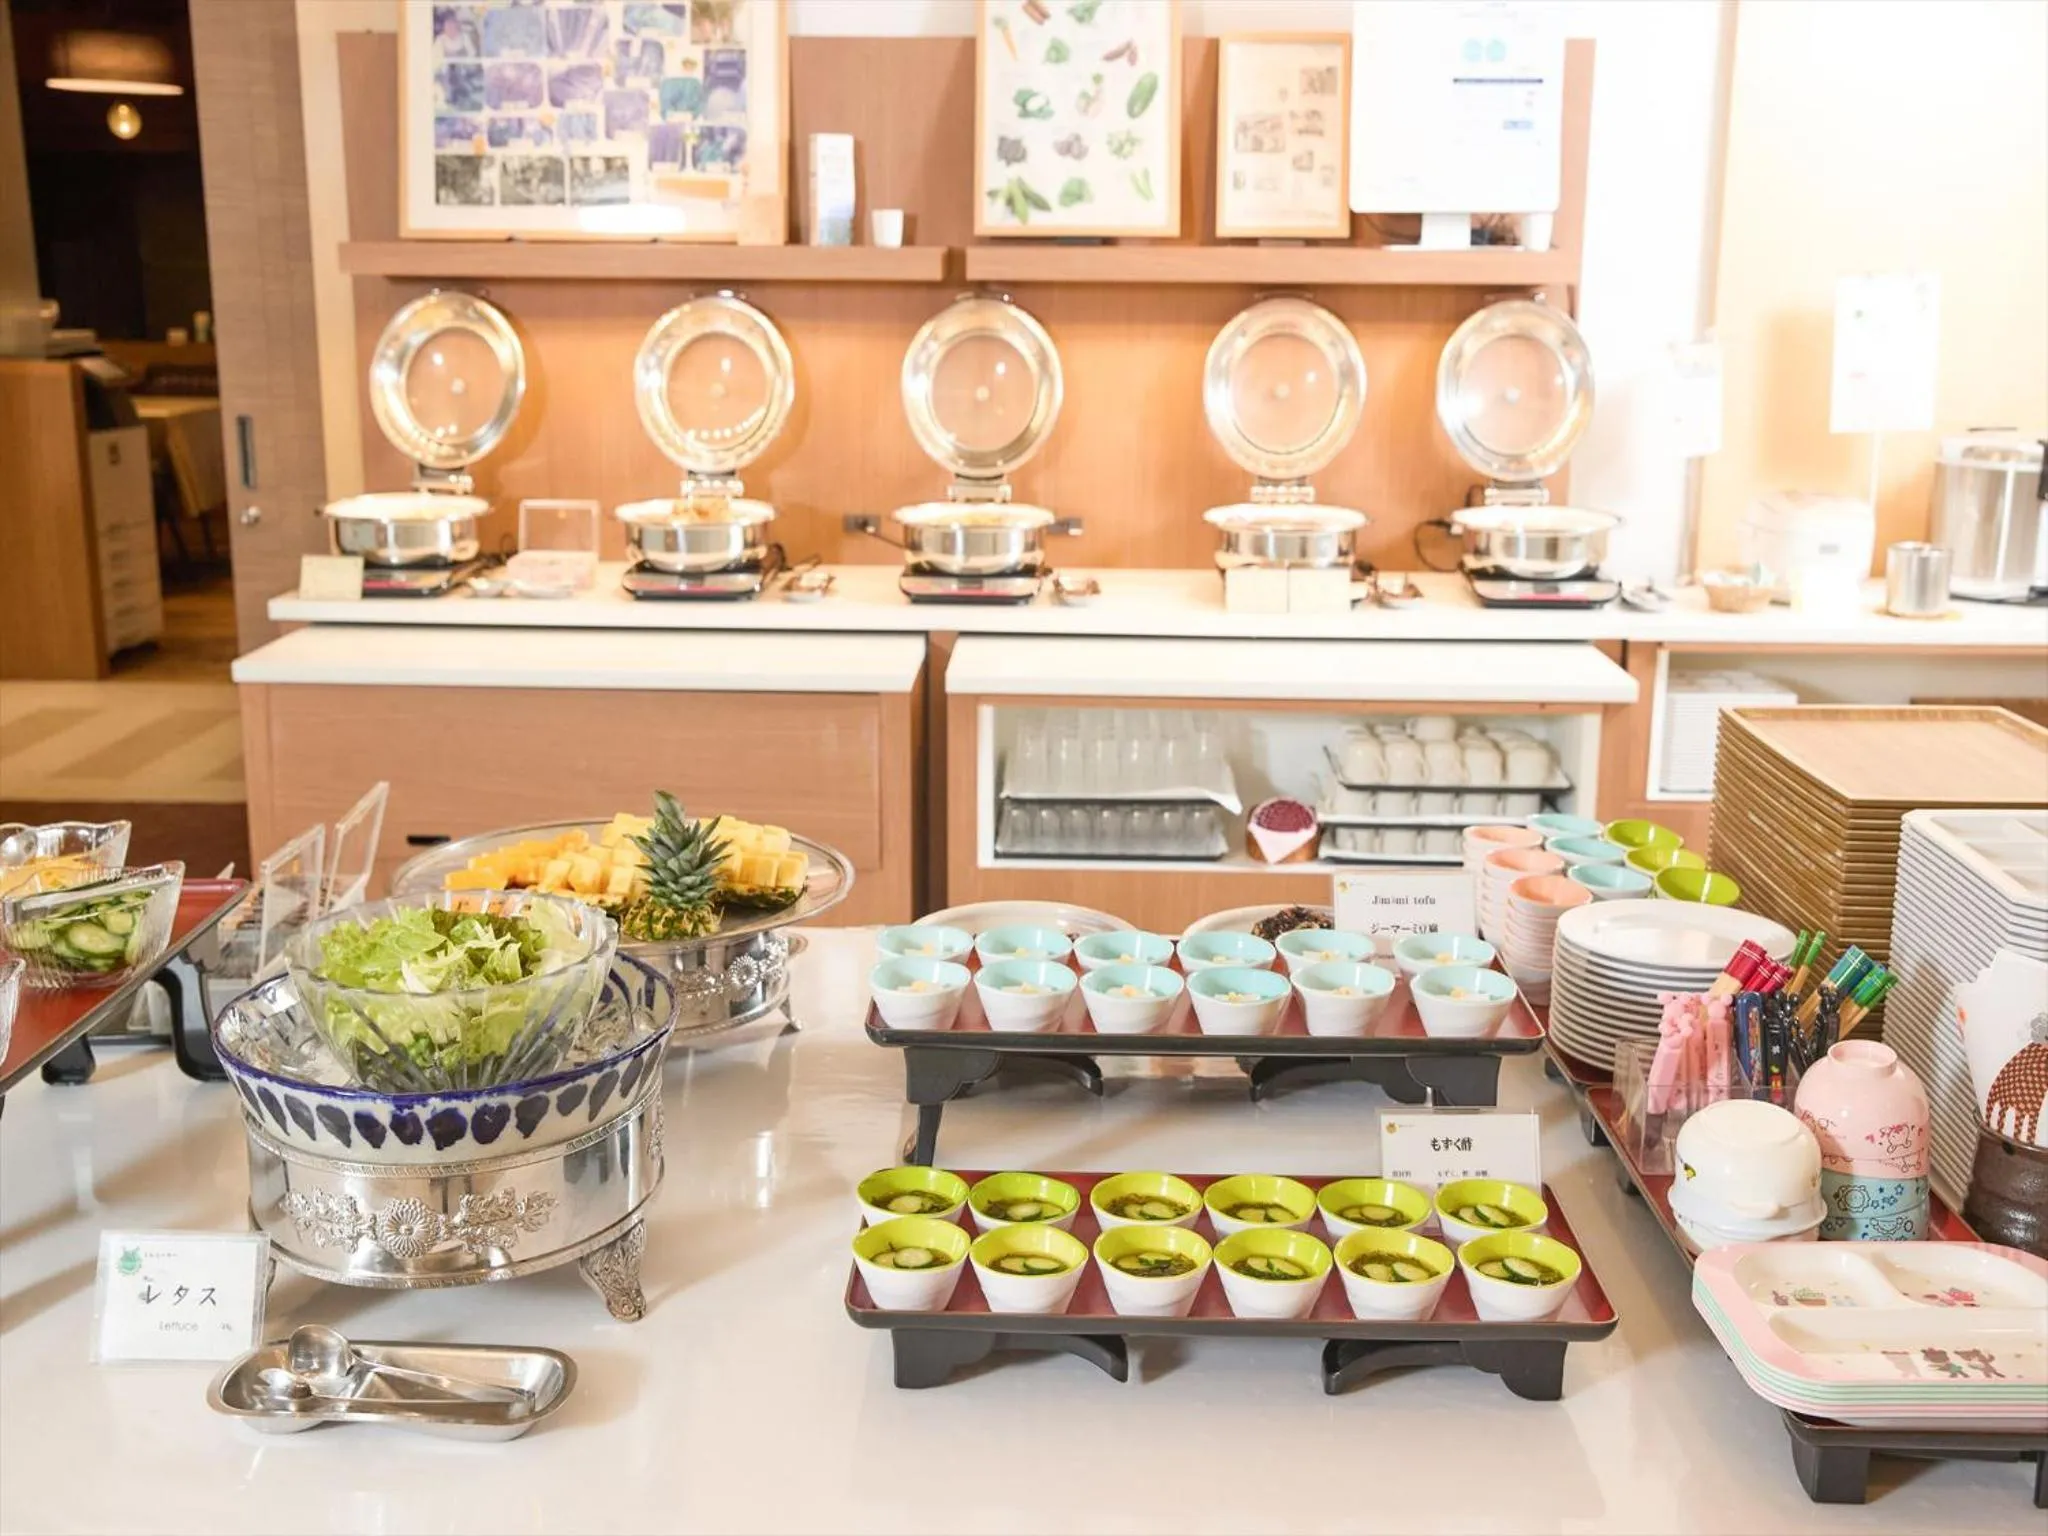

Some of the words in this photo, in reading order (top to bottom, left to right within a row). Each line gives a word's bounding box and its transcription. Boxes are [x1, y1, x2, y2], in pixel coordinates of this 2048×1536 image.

[1414, 895, 1436, 905] tofu
[1431, 1137, 1473, 1152] もずく酢
[144, 1284, 218, 1308] レタス
